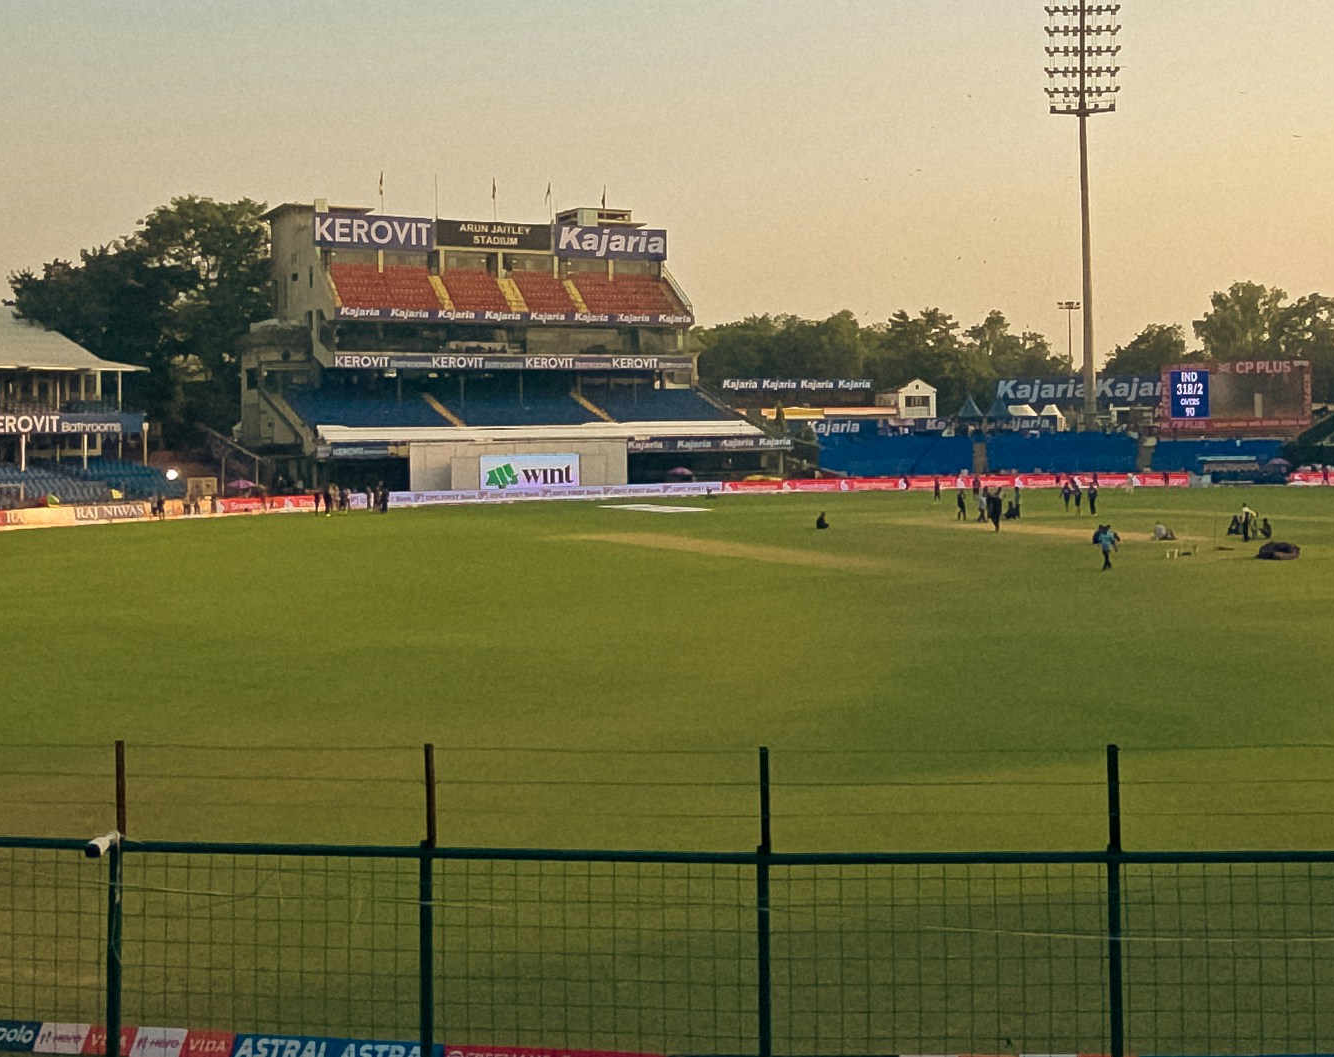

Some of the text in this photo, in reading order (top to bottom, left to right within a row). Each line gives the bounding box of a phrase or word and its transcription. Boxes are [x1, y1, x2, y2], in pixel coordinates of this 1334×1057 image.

[314, 217, 431, 245] KEROVIT
[459, 223, 532, 235] ARUN JAITLEY
[473, 235, 518, 245] STADIUM
[558, 227, 665, 258] Kajaria
[340, 307, 380, 317] Kajaria
[390, 308, 429, 319] Kajaria
[438, 310, 475, 320] Kajaria
[484, 310, 521, 321] Kajaria
[530, 312, 565, 323] Kajaria
[573, 313, 609, 323] Kajaria
[658, 314, 692, 324] Kajaria
[335, 356, 389, 368] KEROVIT
[432, 357, 484, 368] KEROVIT
[526, 358, 574, 368] KEROVIT
[612, 358, 658, 368] KEROVIT
[1236, 361, 1291, 373] CP PLUS
[1181, 372, 1197, 382] IND
[723, 379, 871, 390] Kajaria Kajaria Kajaria Kajaria
[1176, 383, 1203, 395] 318/2
[61, 421, 122, 433] Bathrooms
[627, 441, 663, 450] Kajaria
[677, 440, 711, 449] Kajaria
[759, 438, 791, 447] Kajaria
[76, 503, 144, 519] RAJ NIWAS
[188, 1039, 227, 1052] VIDA
